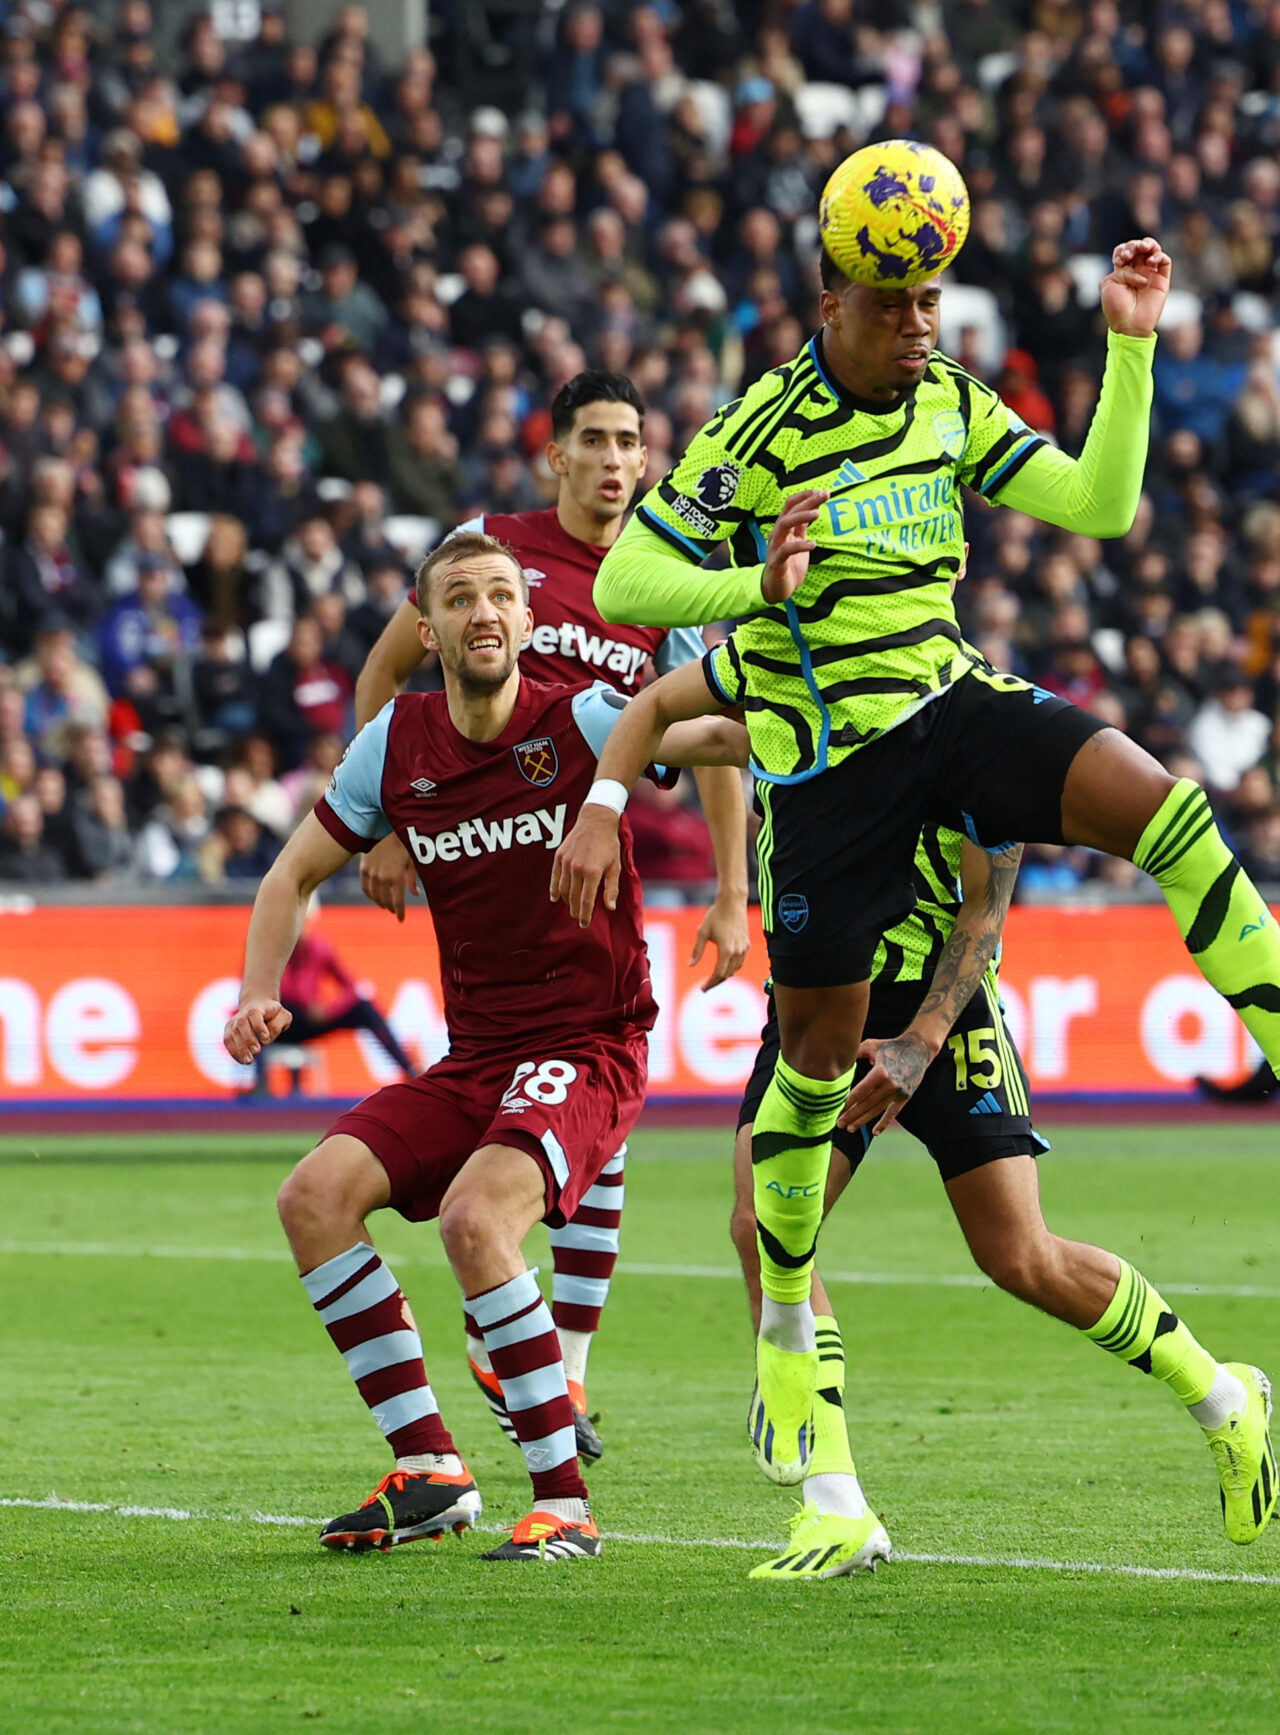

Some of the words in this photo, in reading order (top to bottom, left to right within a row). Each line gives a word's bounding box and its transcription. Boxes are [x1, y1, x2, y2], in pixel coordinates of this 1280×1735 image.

[689, 506, 715, 530] room
[825, 475, 953, 537] Emirate
[899, 512, 955, 552] BETTER
[520, 622, 648, 686] etway
[407, 804, 567, 865] betway
[500, 1059, 577, 1107] 28
[947, 1028, 1002, 1091] 15
[766, 1181, 820, 1198] AFC
